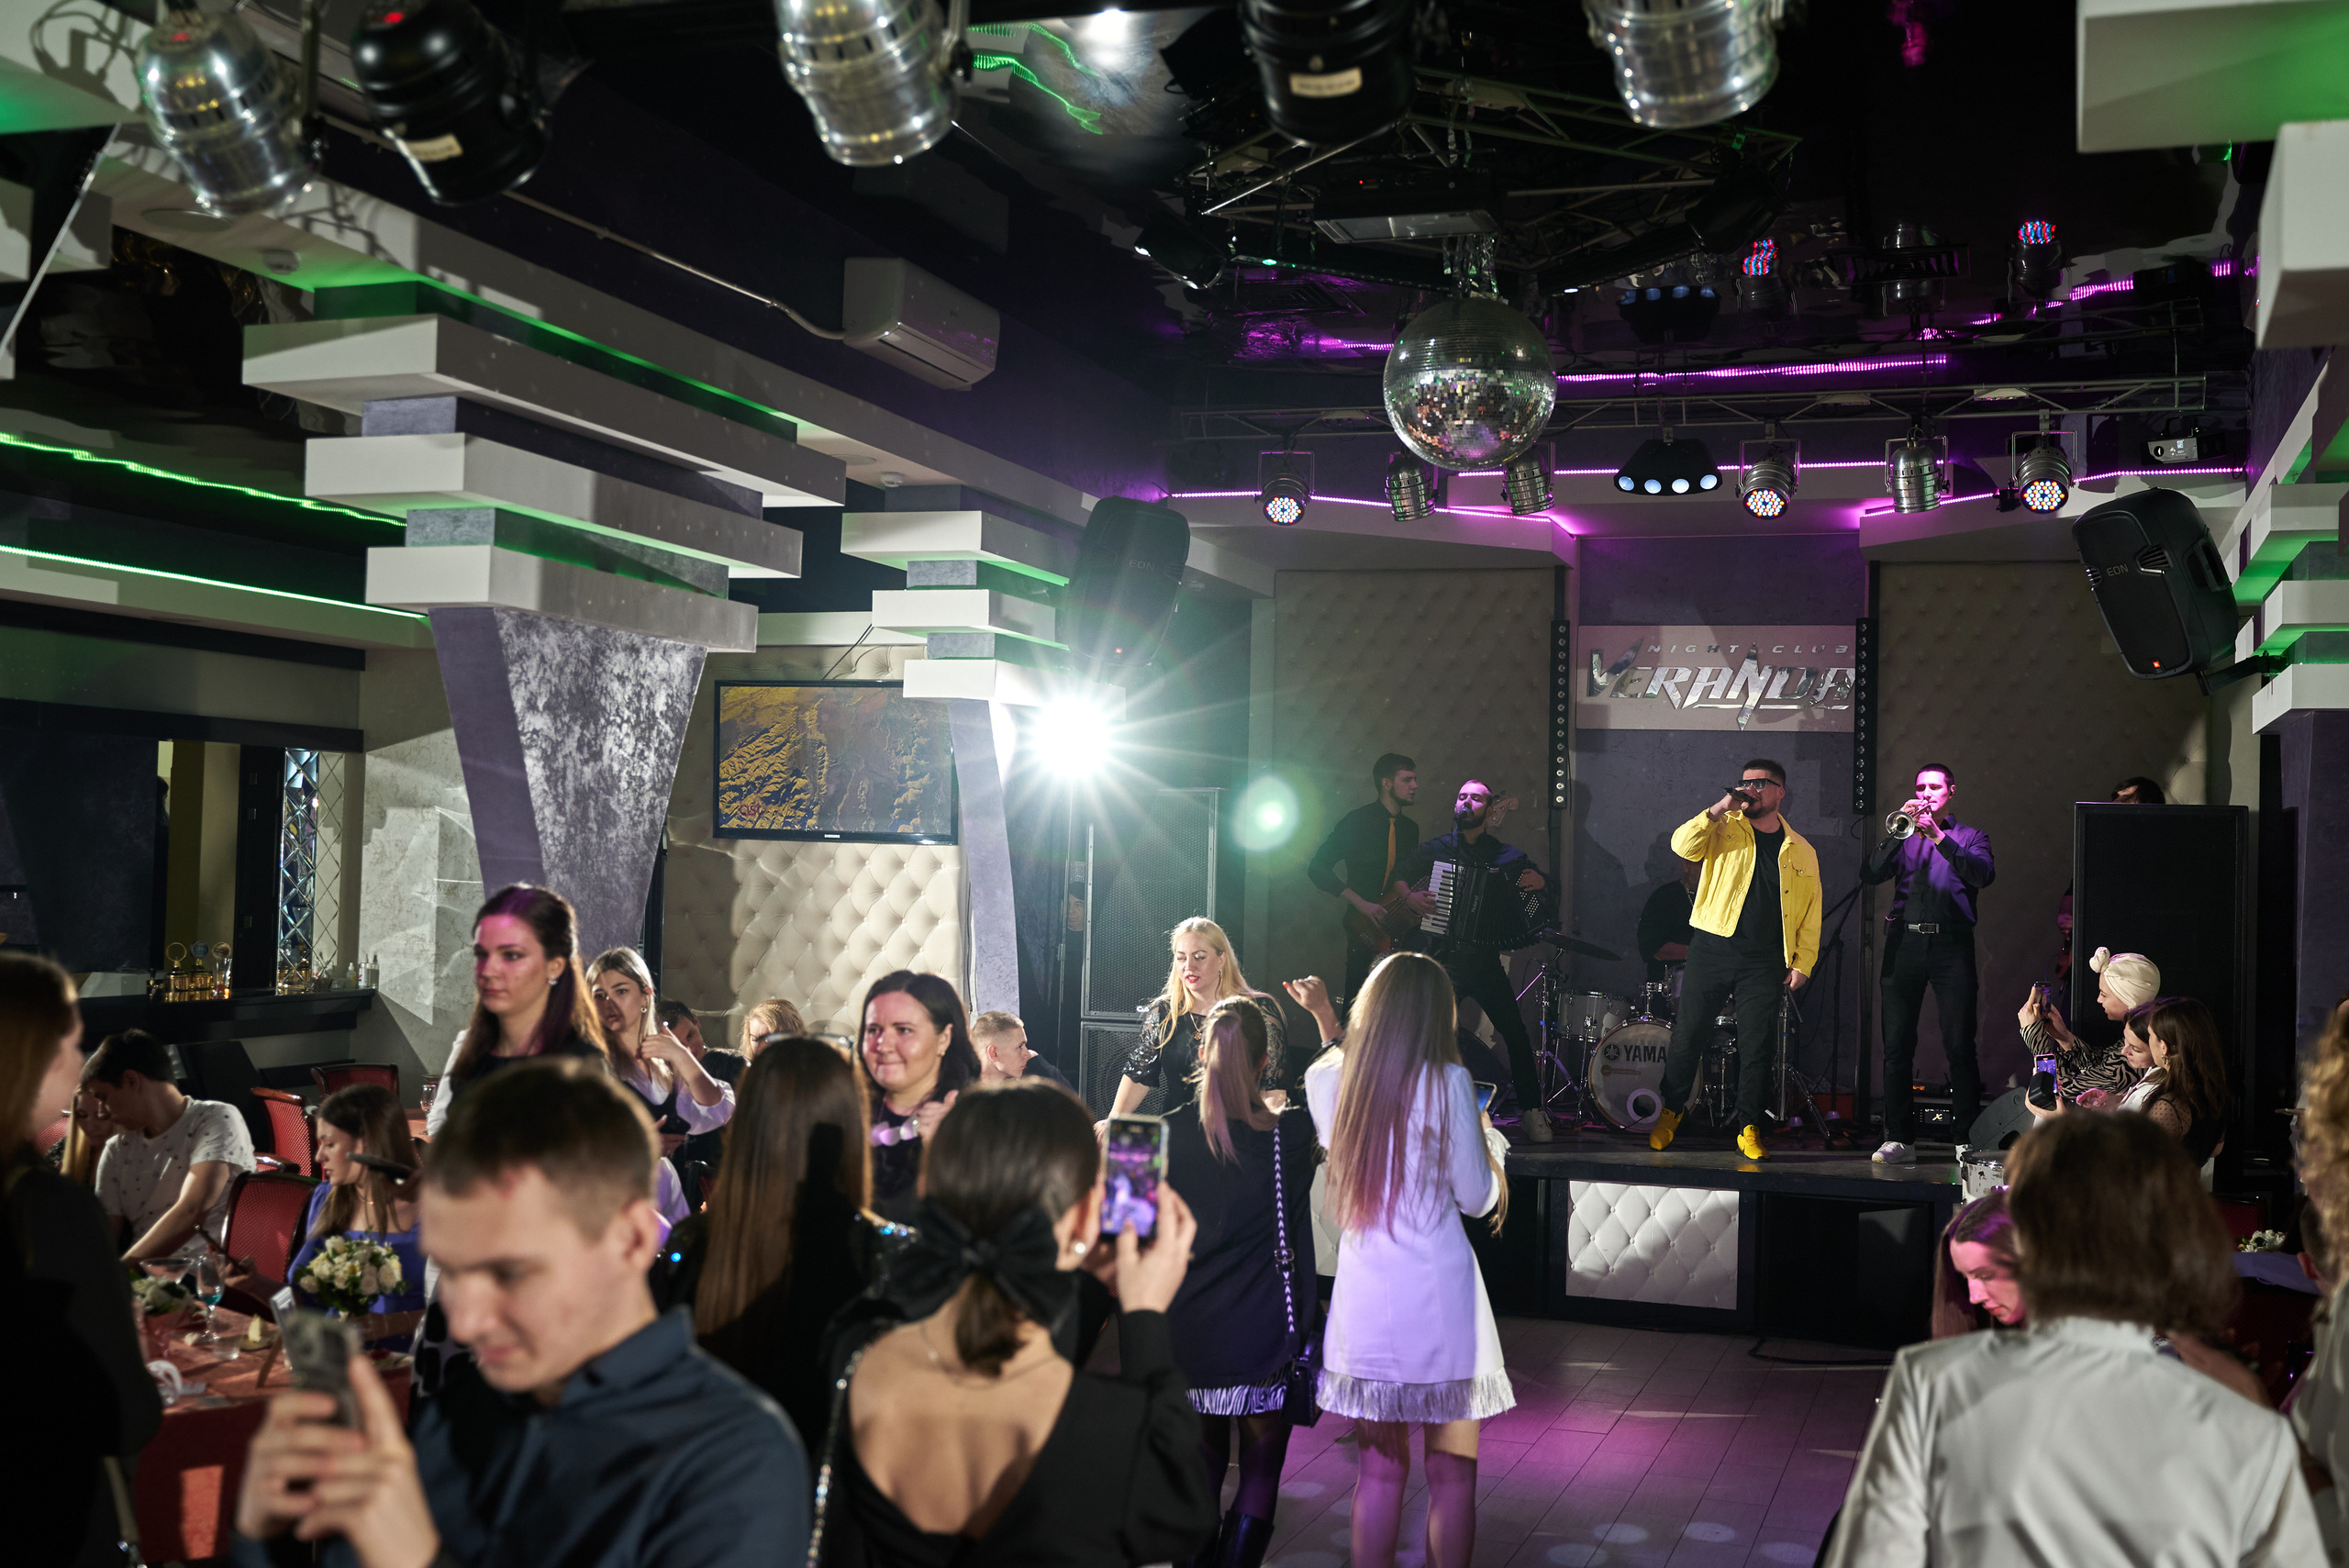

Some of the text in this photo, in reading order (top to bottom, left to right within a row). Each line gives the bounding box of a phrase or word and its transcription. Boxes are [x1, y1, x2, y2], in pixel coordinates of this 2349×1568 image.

[2107, 563, 2129, 576] EON
[1647, 644, 1849, 654] NIGHT CLUB
[1586, 637, 1856, 731] VERANDA
[1623, 1044, 1667, 1063] YAMA
